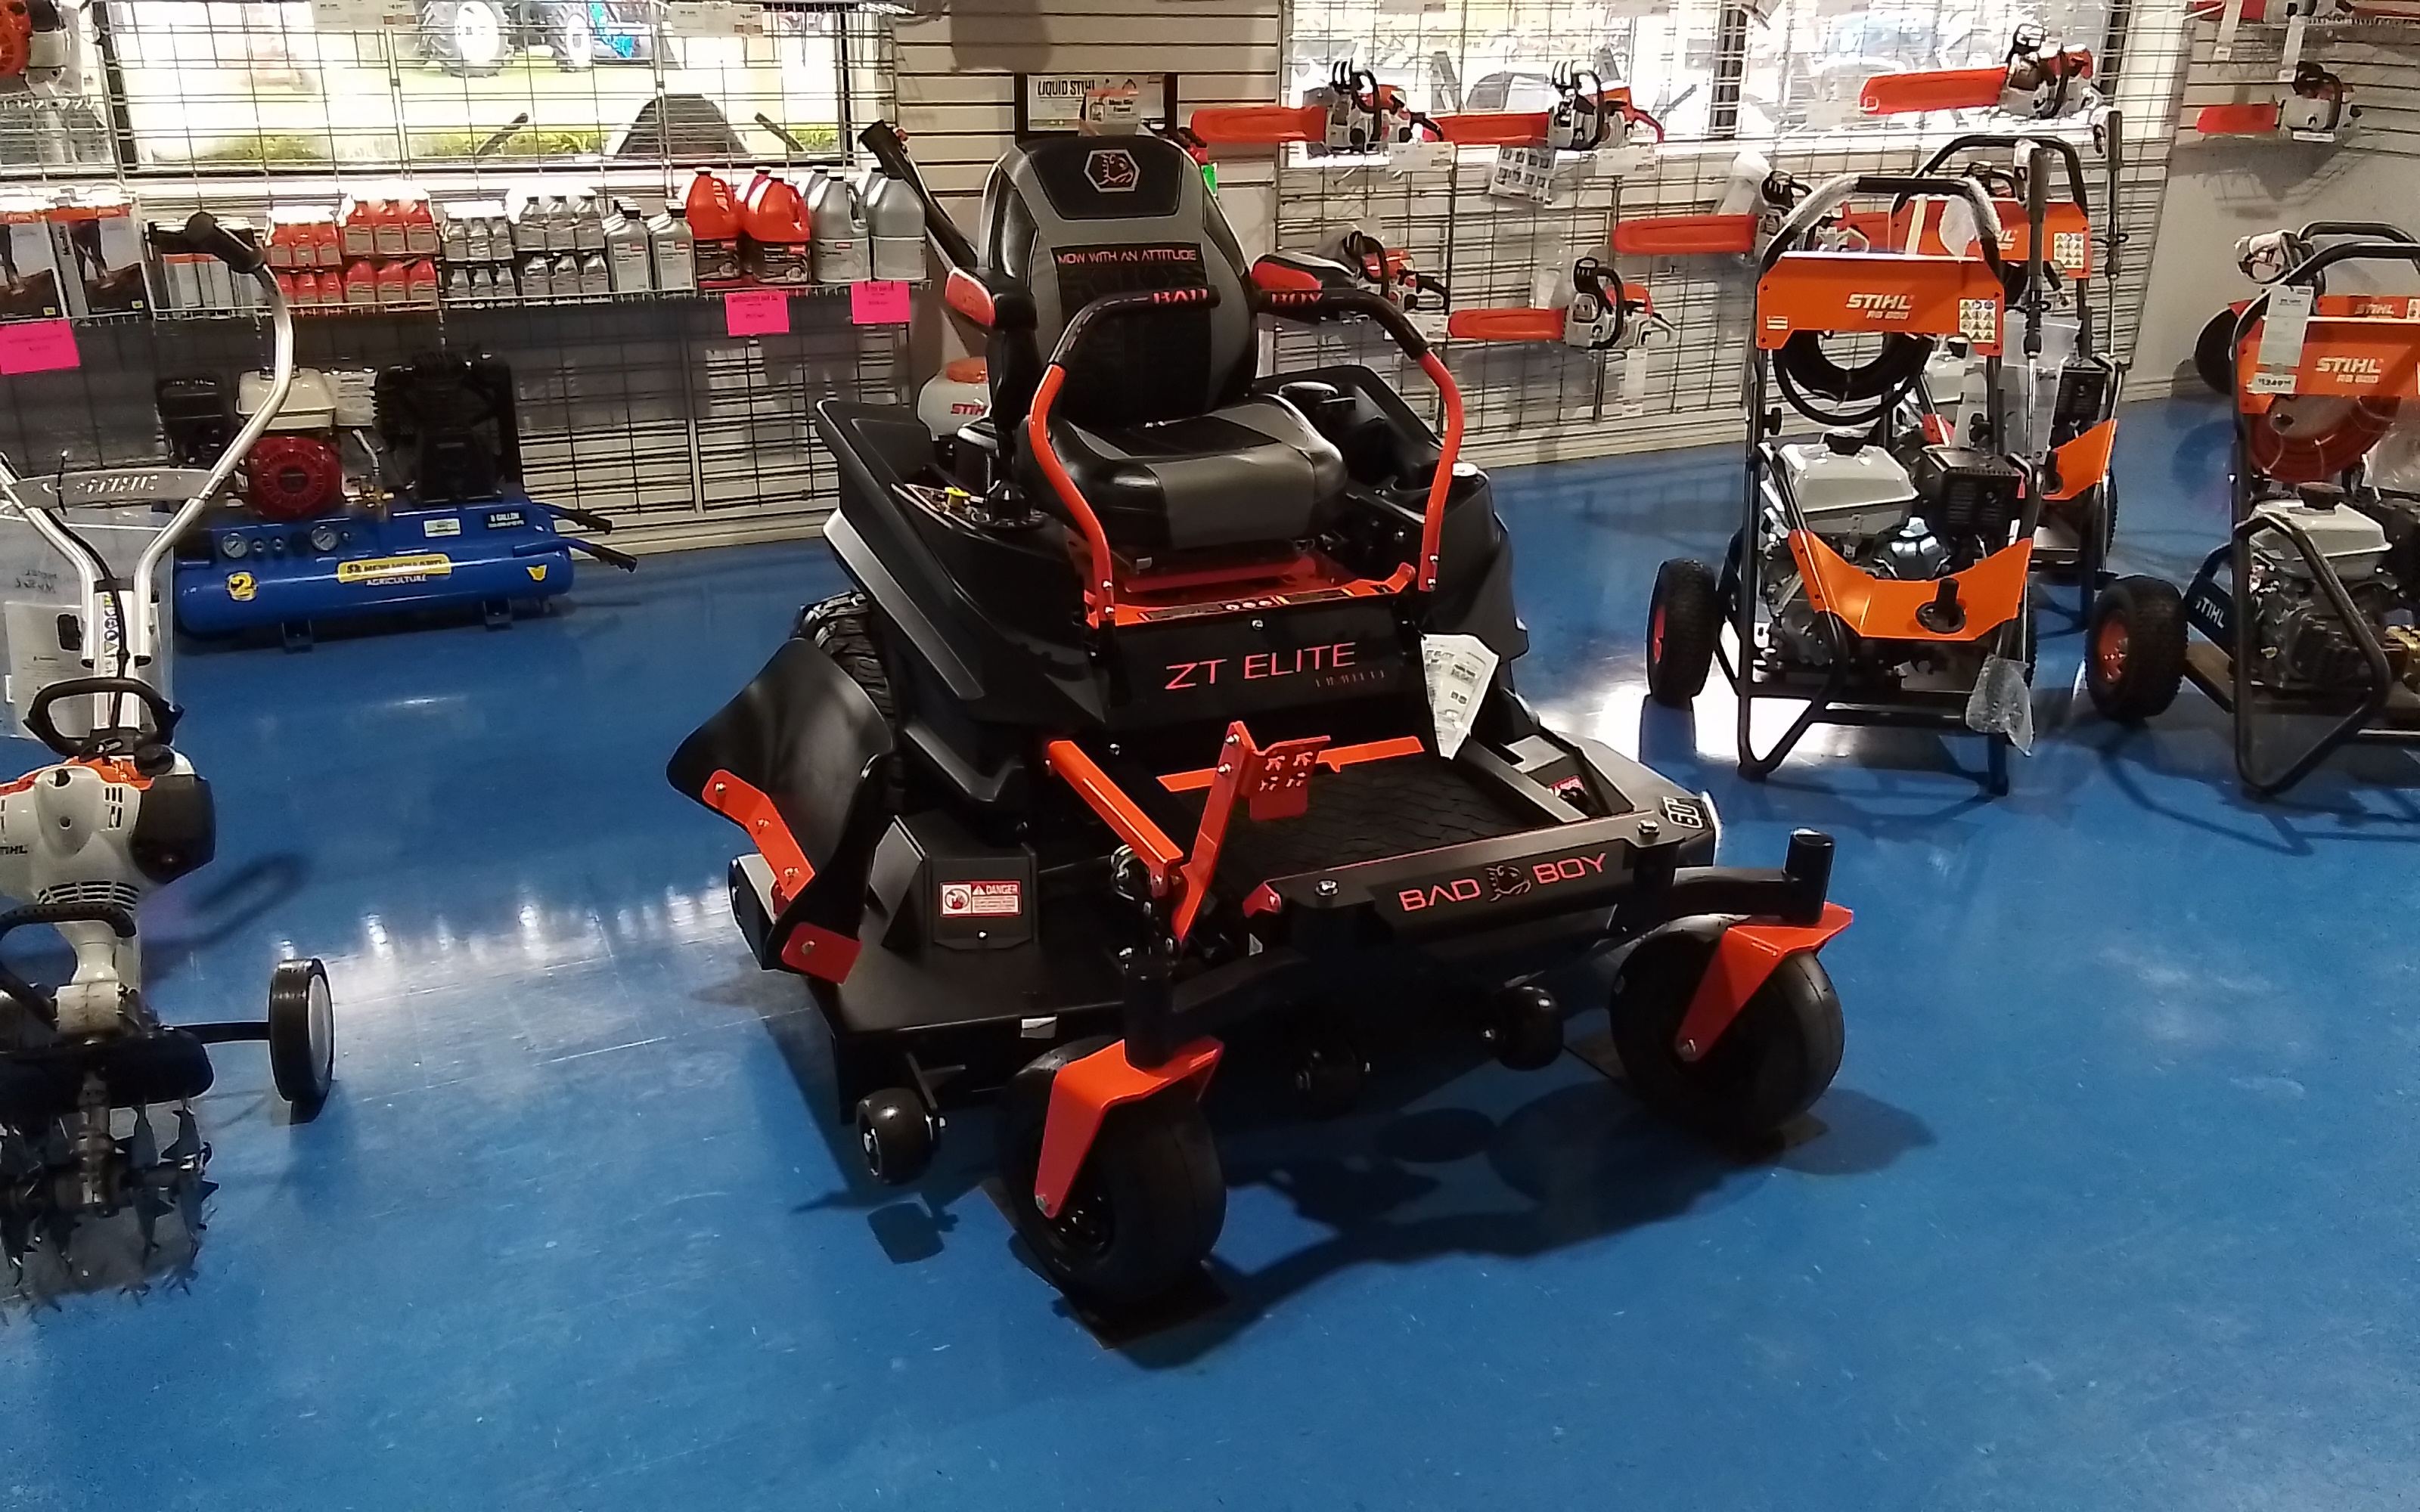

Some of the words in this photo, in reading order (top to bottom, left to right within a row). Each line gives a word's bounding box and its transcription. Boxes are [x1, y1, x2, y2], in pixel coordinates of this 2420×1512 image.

[1038, 79, 1067, 97] LIQUID
[1087, 251, 1117, 263] WITH
[1121, 250, 1138, 262] AN
[1141, 249, 1197, 262] ATTITUDE
[1846, 293, 1912, 309] STIHL
[2316, 358, 2381, 373] STIHL
[951, 403, 988, 415] STIH
[366, 574, 427, 586] AGRICULTURE
[1165, 658, 1227, 689] ZT
[1243, 642, 1356, 680] ELITE
[0, 845, 28, 855] TIHL
[986, 884, 1018, 894] DANGER
[1398, 878, 1481, 912] BAD
[1532, 852, 1606, 885] BOY
